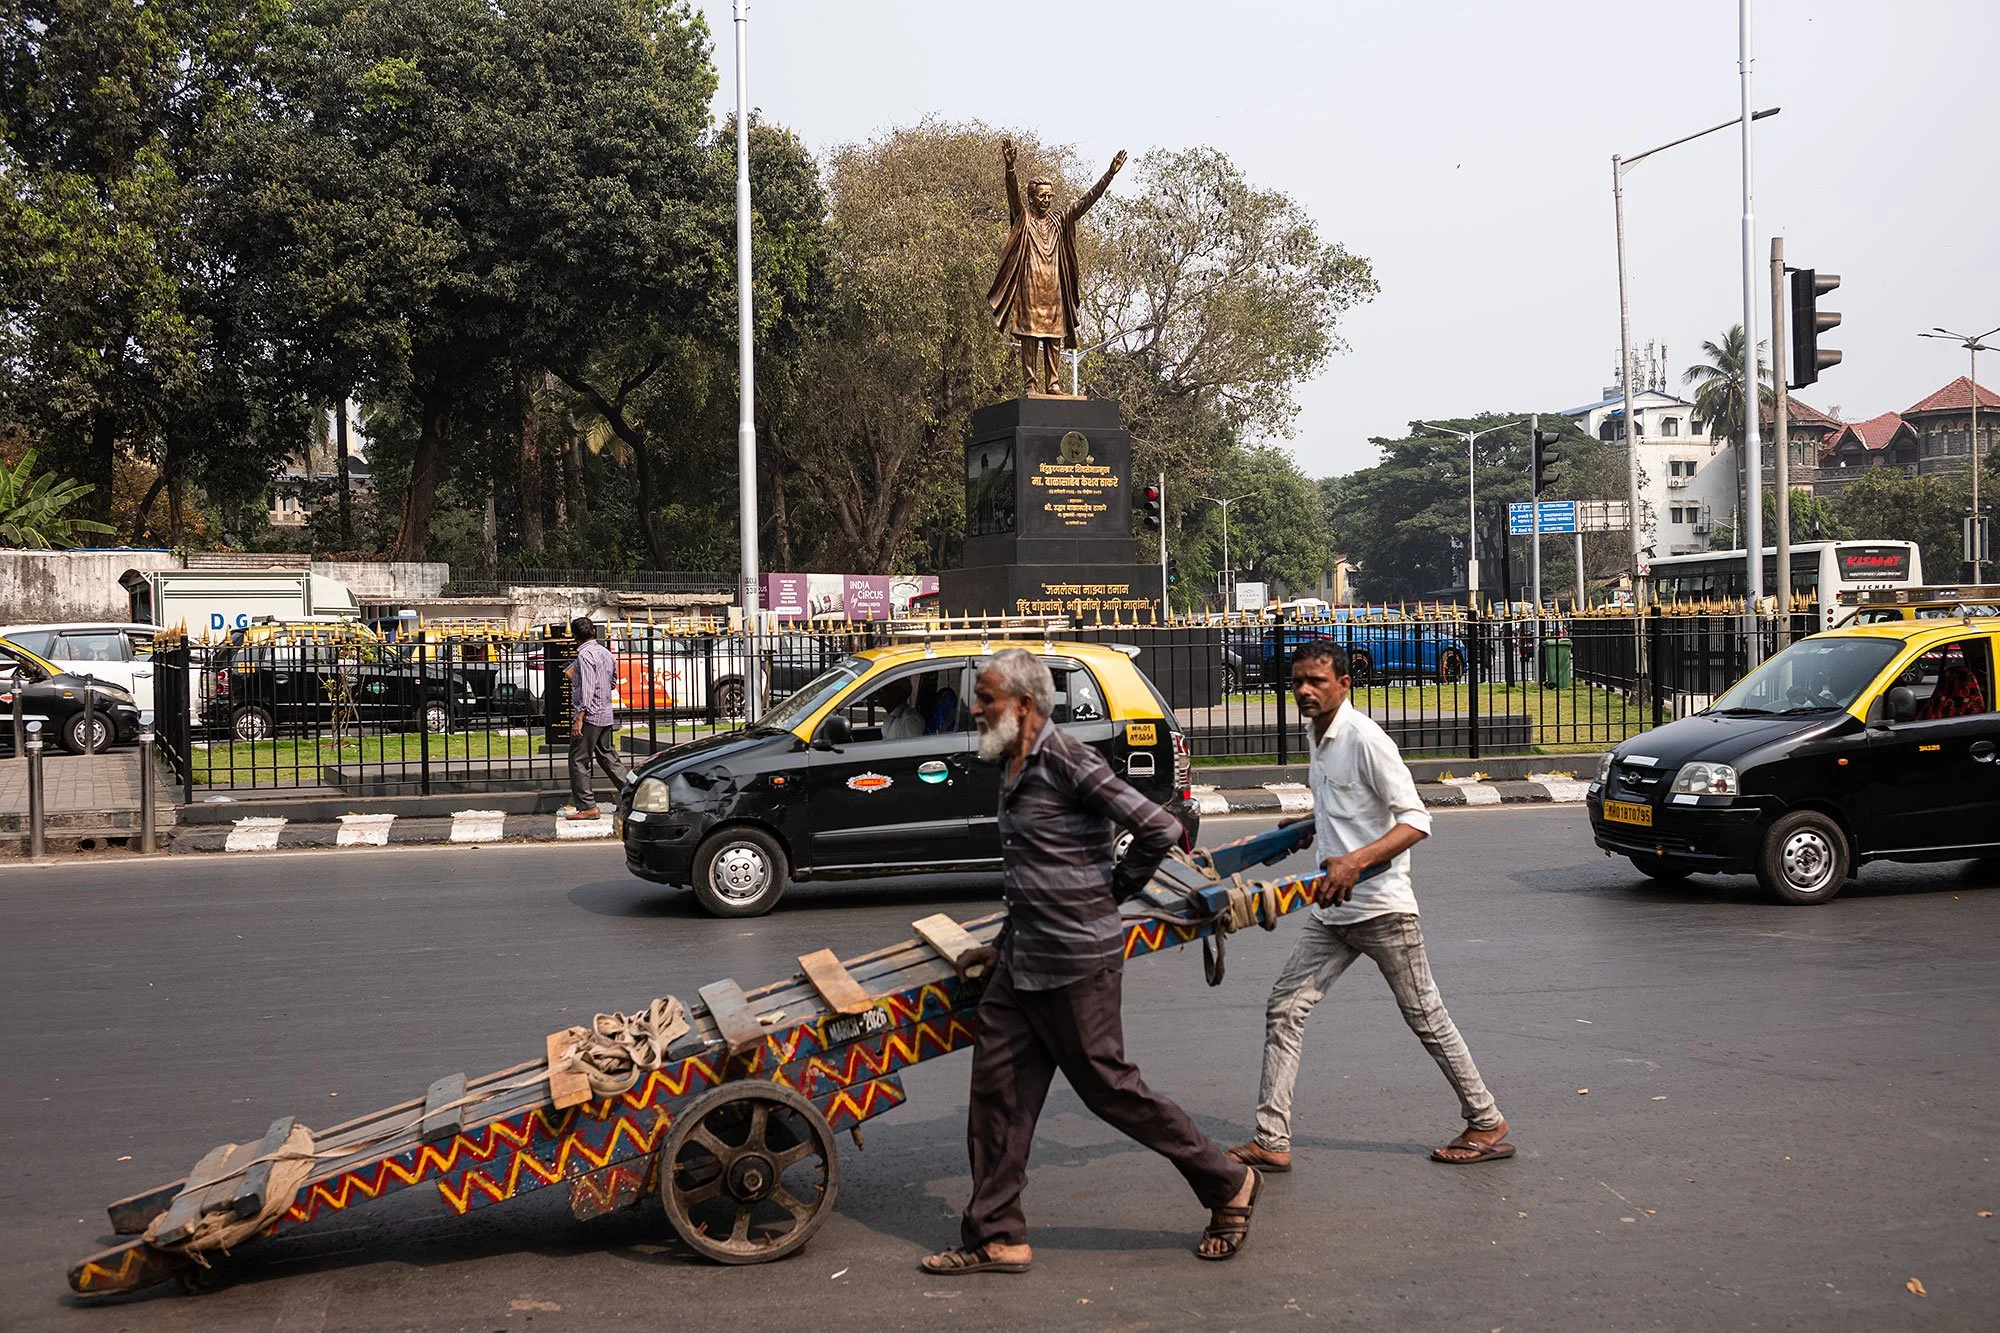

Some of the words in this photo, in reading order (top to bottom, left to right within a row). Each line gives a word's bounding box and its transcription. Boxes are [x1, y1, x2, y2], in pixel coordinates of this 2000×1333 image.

[1044, 475, 1080, 486] बाळासाहेब
[1081, 475, 1099, 486] केशव
[1099, 475, 1119, 487] ठाकरे
[1846, 555, 1902, 567] KISMAT
[1082, 584, 1106, 596] माझ्या
[1107, 584, 1129, 595] तमाम
